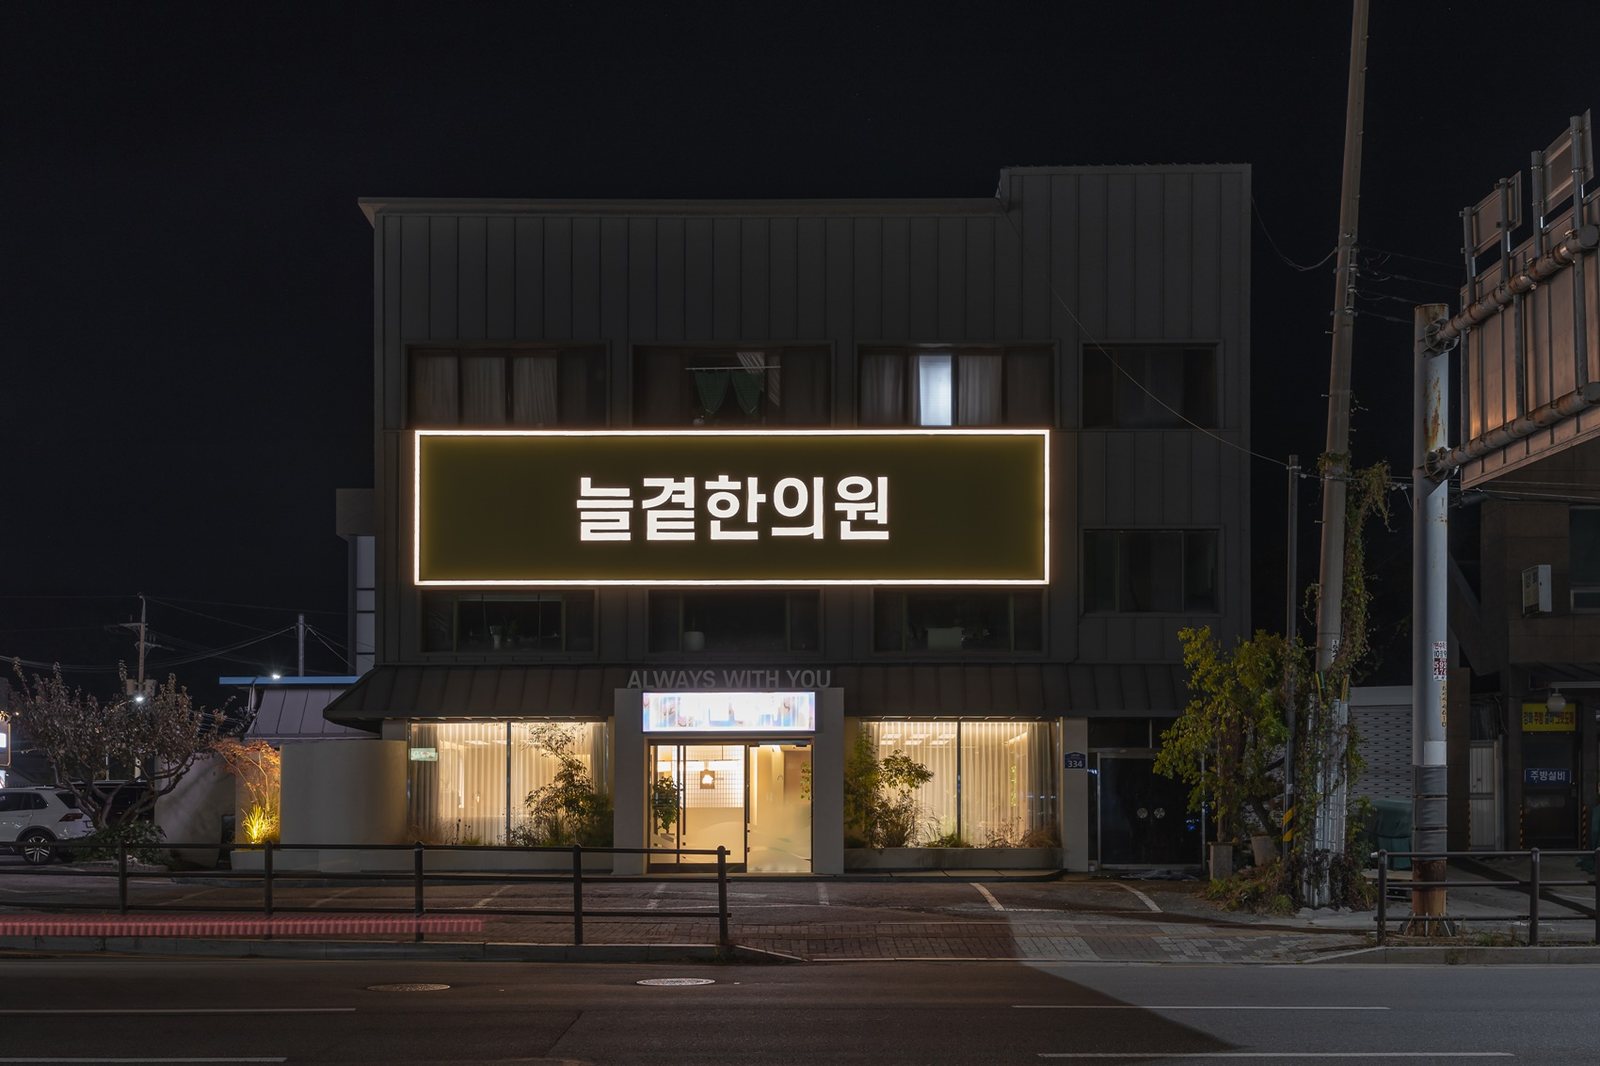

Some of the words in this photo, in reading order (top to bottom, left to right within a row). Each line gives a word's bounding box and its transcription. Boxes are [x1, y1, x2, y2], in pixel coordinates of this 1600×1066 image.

[576, 474, 890, 542] 늘곁한의원
[627, 670, 716, 688] ALWAYS
[723, 670, 779, 688] WITH
[786, 670, 831, 688] YOU
[1068, 760, 1083, 768] 334
[1530, 770, 1566, 782] 주방설비
